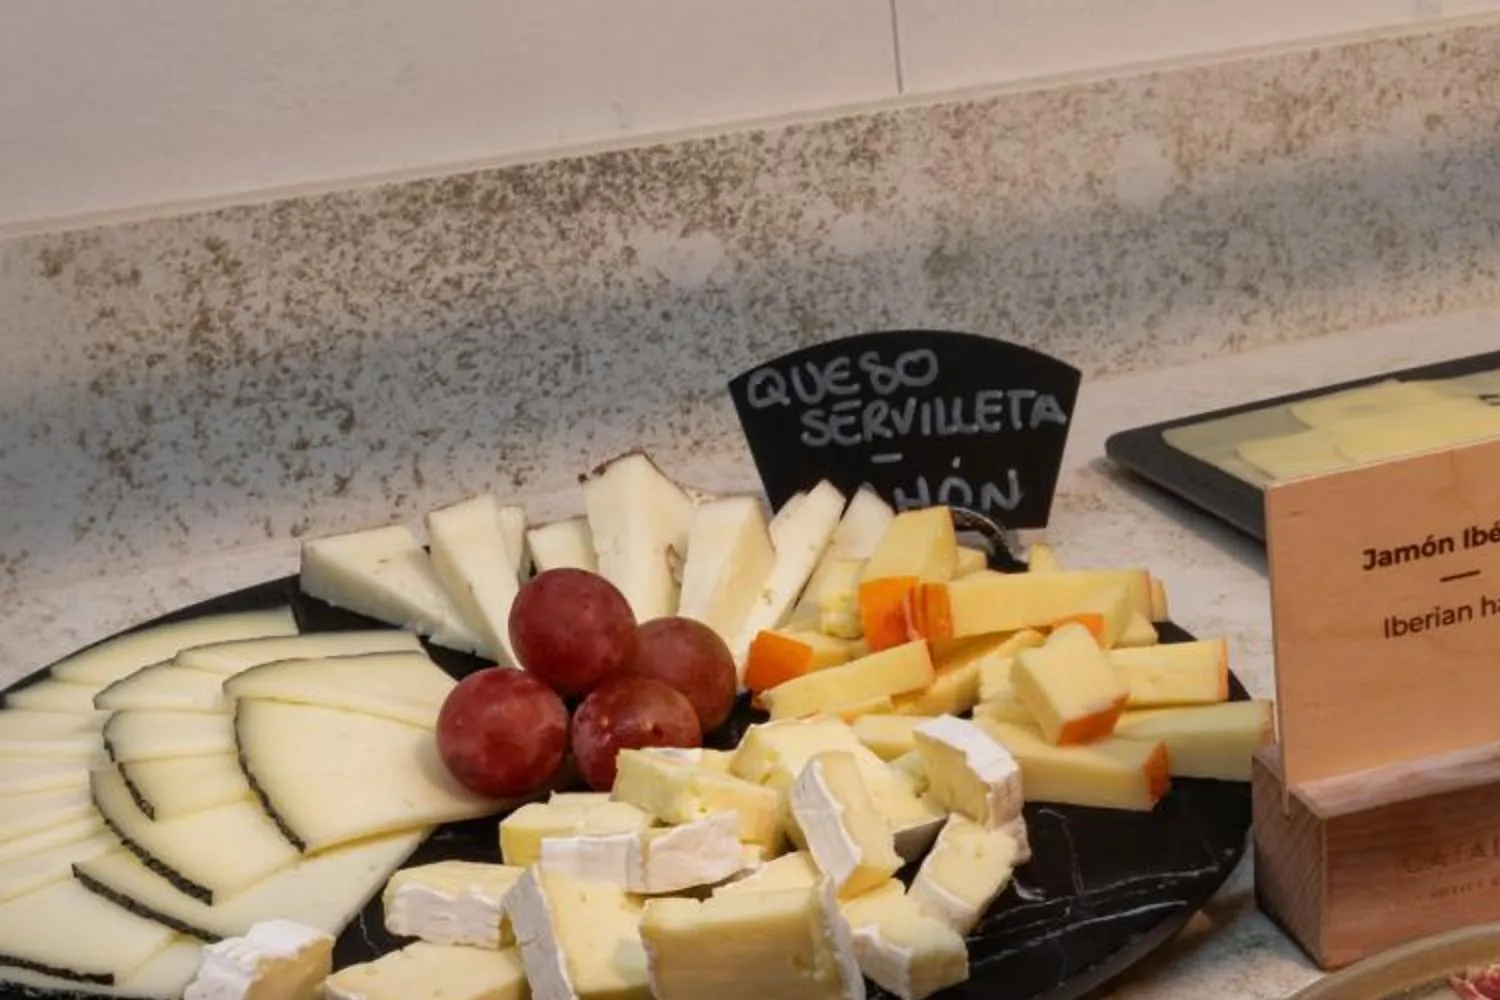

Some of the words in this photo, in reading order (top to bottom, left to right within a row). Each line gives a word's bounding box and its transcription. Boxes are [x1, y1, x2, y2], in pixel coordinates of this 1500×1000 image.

[747, 349, 938, 408] QUESO
[801, 389, 1067, 446] SERVILLETA
[893, 456, 1026, 511] HÓN
[1363, 535, 1455, 571] Jamón
[1384, 604, 1474, 640] Iberian
